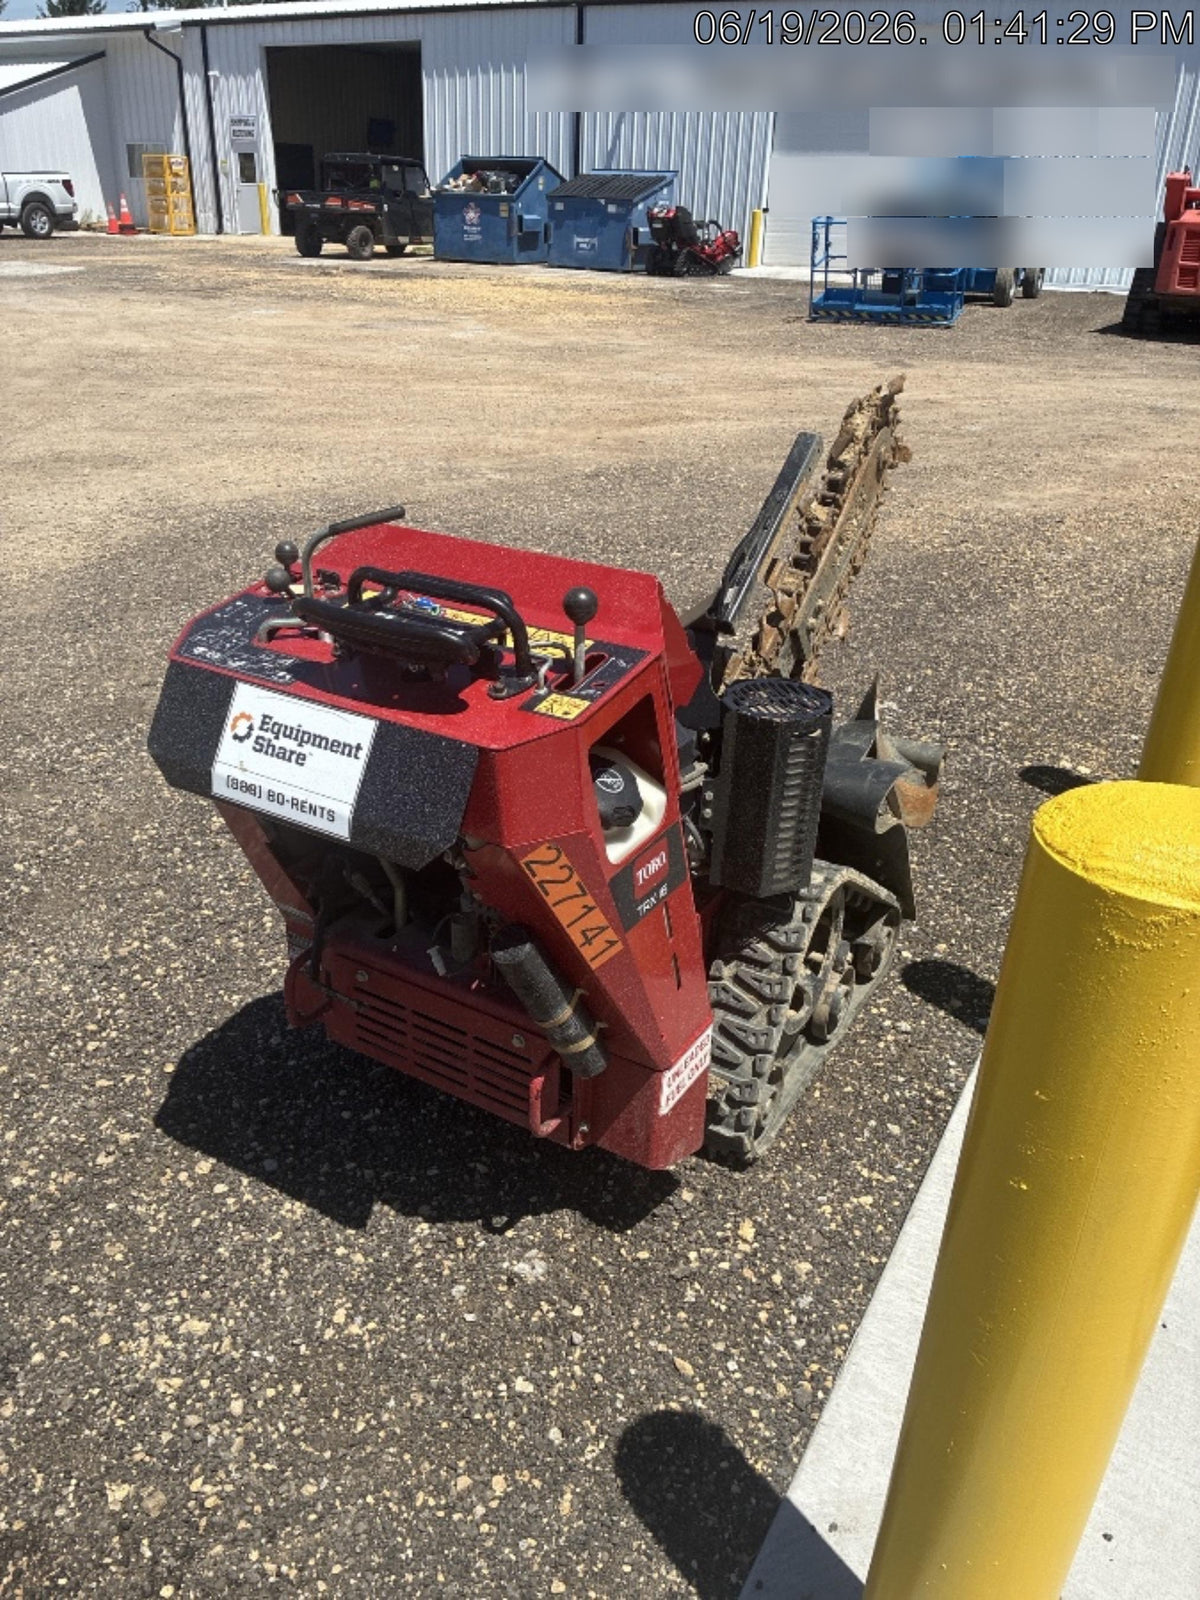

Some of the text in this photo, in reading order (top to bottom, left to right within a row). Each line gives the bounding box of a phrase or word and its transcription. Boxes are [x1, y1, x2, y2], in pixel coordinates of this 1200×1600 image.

[252, 735, 307, 767] Share
[258, 714, 363, 760] Equipment
[267, 788, 336, 823] 80-RENTS
[636, 851, 667, 886] TORO
[522, 845, 620, 963] 227141
